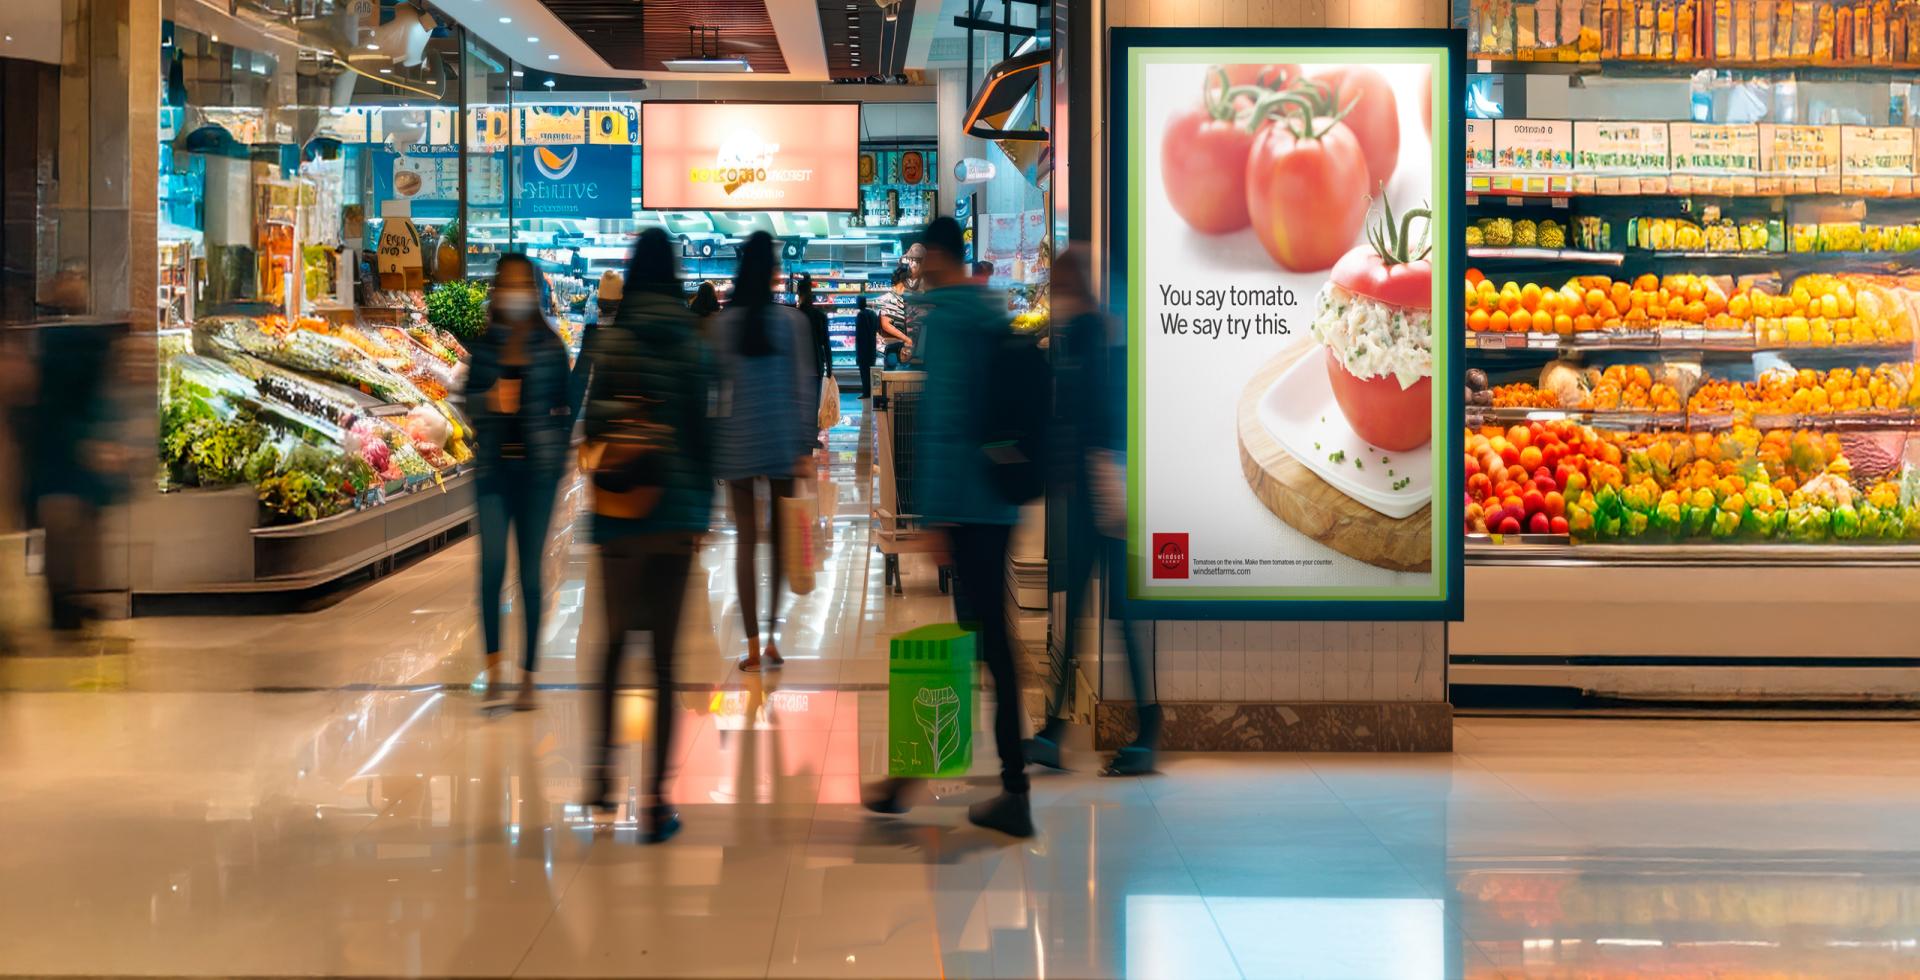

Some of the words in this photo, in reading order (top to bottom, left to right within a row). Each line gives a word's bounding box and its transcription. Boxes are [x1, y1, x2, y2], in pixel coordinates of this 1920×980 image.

[1159, 284, 1192, 306] You
[1195, 290, 1226, 311] say
[1229, 285, 1298, 306] tomato.
[1160, 313, 1188, 335] We
[1192, 318, 1223, 340] say
[1226, 314, 1252, 340] try
[1255, 313, 1291, 335] this.
[1193, 558, 1216, 566] Tomatoes
[1224, 558, 1232, 566] the
[1244, 558, 1259, 566] Make
[1259, 558, 1272, 566] them
[1272, 558, 1295, 566] tomatoes
[1302, 559, 1313, 567] your
[1193, 566, 1251, 576] windsetfarms.com
